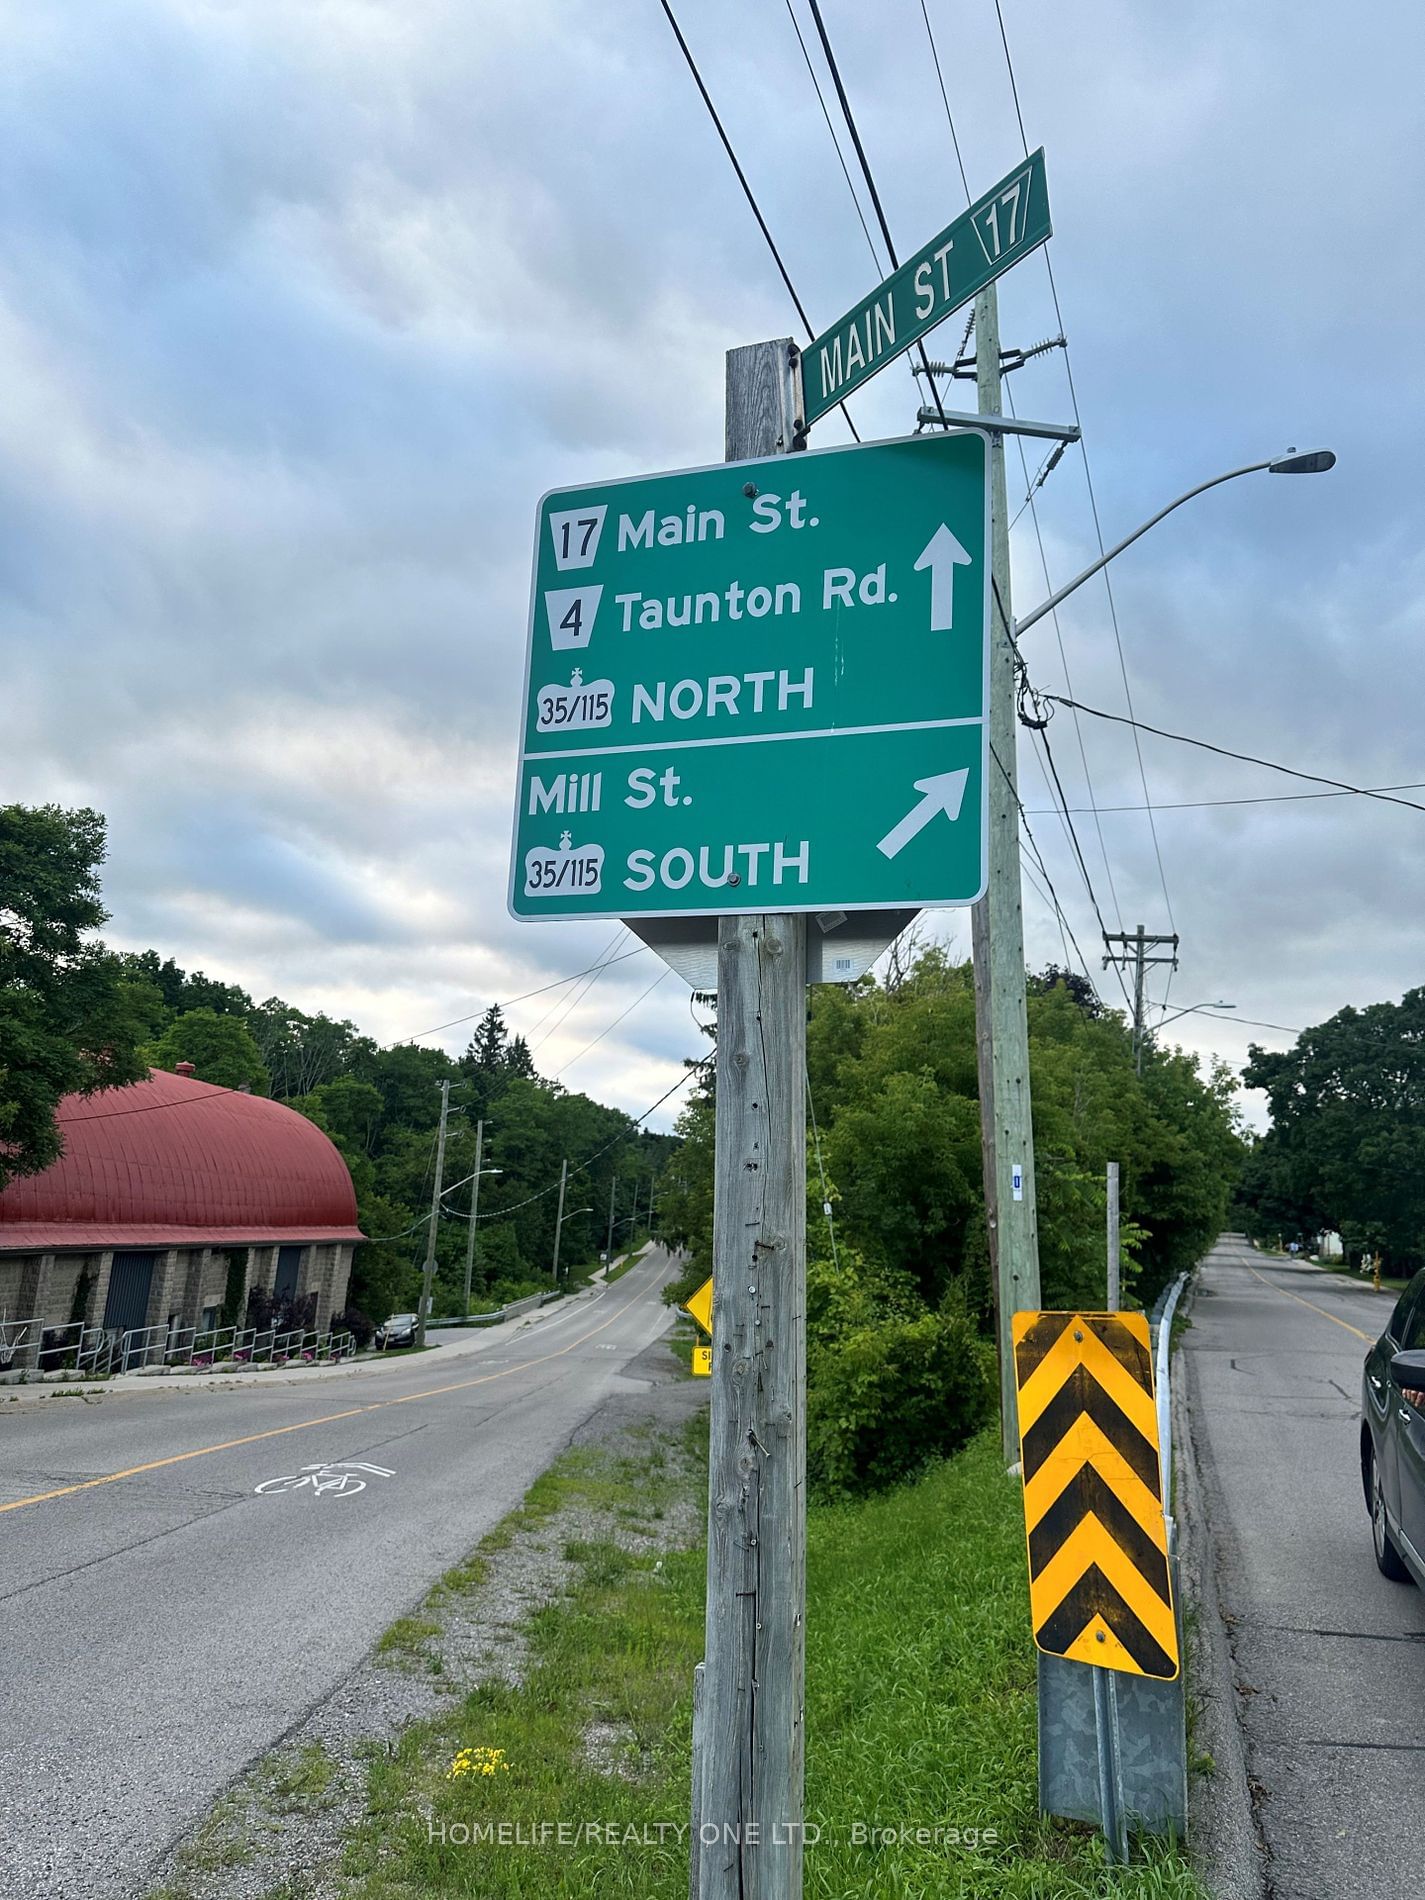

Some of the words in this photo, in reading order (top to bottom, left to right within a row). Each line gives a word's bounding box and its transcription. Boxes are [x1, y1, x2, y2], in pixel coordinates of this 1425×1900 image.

[820, 292, 896, 398] MAIN
[914, 239, 954, 320] ST
[985, 182, 1021, 257] 17
[561, 517, 598, 559] 17
[617, 504, 725, 552] Main
[749, 490, 820, 533] St.
[559, 598, 583, 637] 4
[615, 581, 801, 632] Taunton
[822, 562, 899, 610] Rd.
[540, 693, 609, 725] 35/115
[631, 667, 814, 724] NORTH
[528, 772, 602, 815] Mill
[624, 766, 693, 809] St.
[528, 858, 599, 889] 35/115
[623, 840, 809, 892] SOUTH
